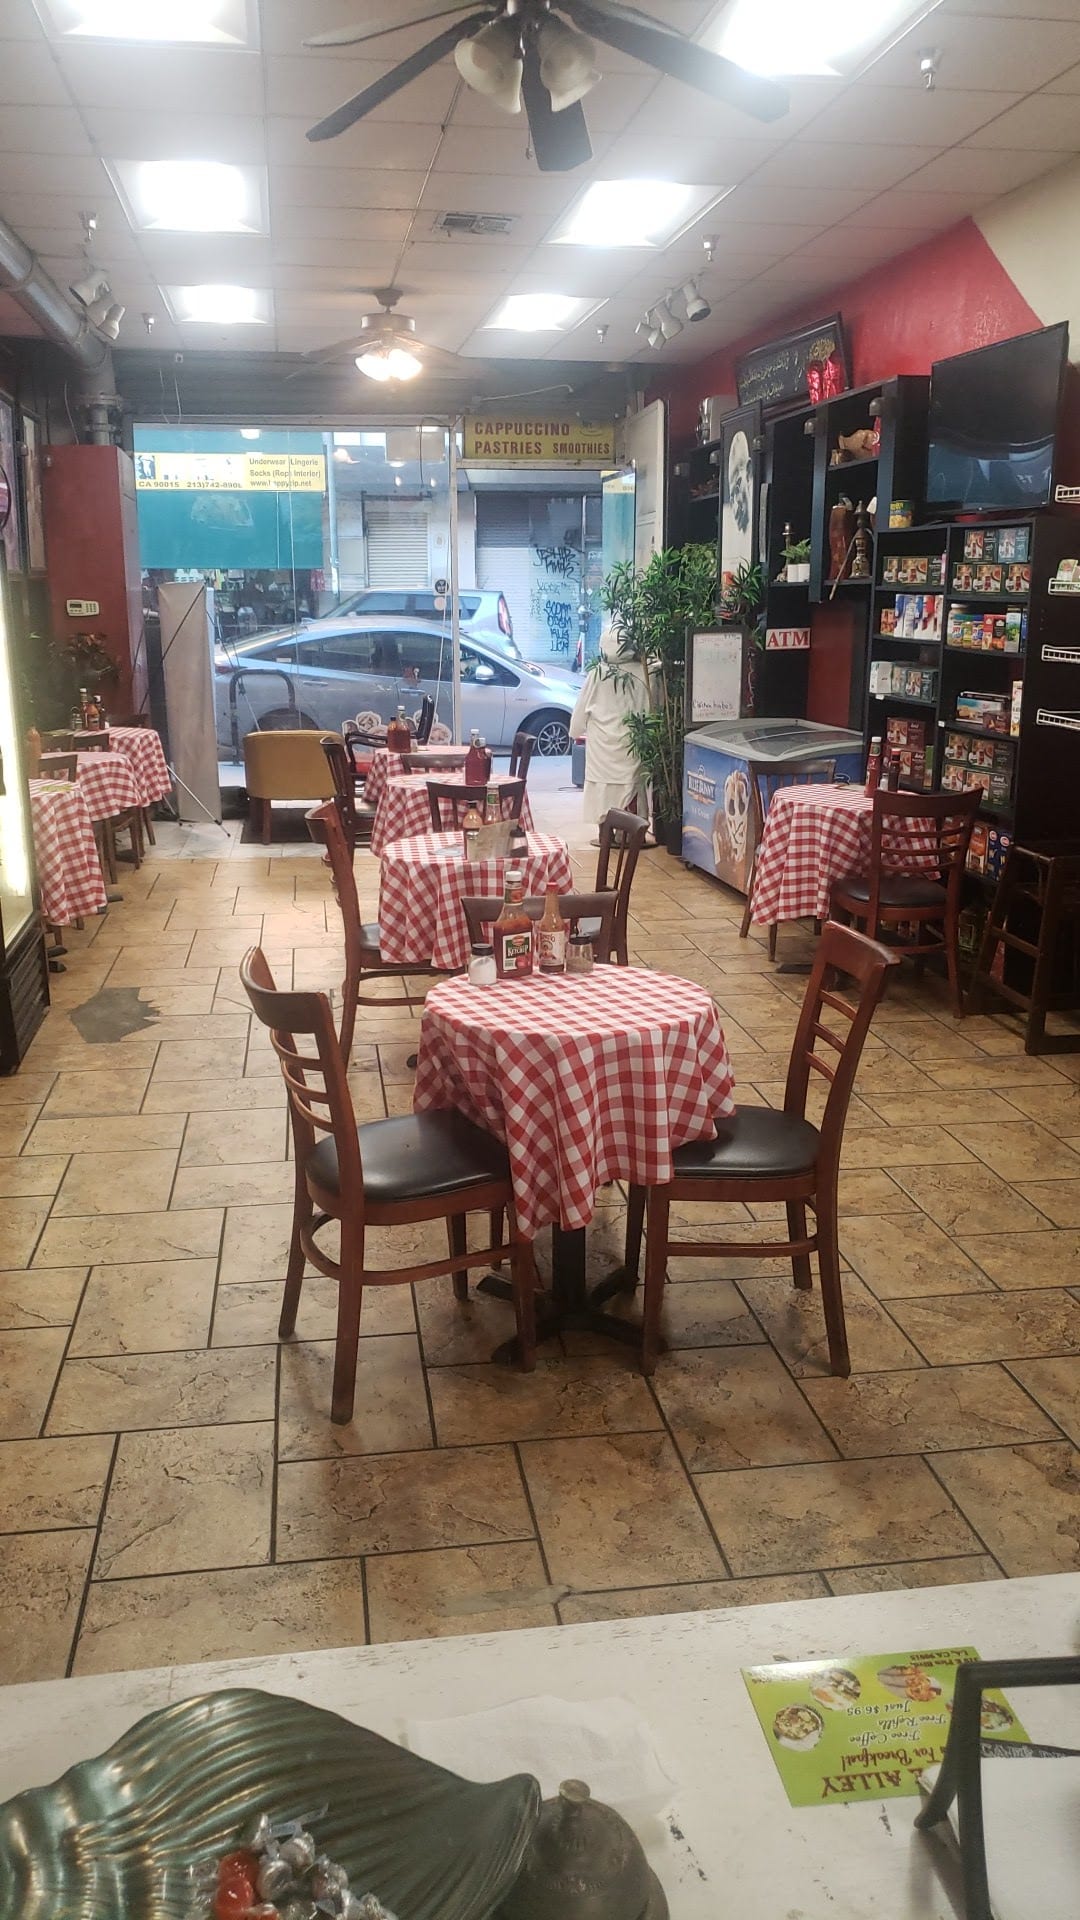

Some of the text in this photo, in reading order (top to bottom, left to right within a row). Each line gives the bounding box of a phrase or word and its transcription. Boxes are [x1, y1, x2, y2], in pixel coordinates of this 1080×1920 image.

[474, 422, 570, 436] CAPPUCCINO
[474, 441, 610, 455] PASTRIES SMOOTHIES
[291, 458, 319, 467] Lingerie
[767, 631, 809, 648] ATM
[847, 1700, 912, 1716] Just $6.95
[878, 1713, 947, 1730] Free Refills
[849, 1730, 921, 1746] Free Coffee
[841, 1748, 912, 1772] Breakfast!
[821, 1769, 901, 1799] ALLEY
